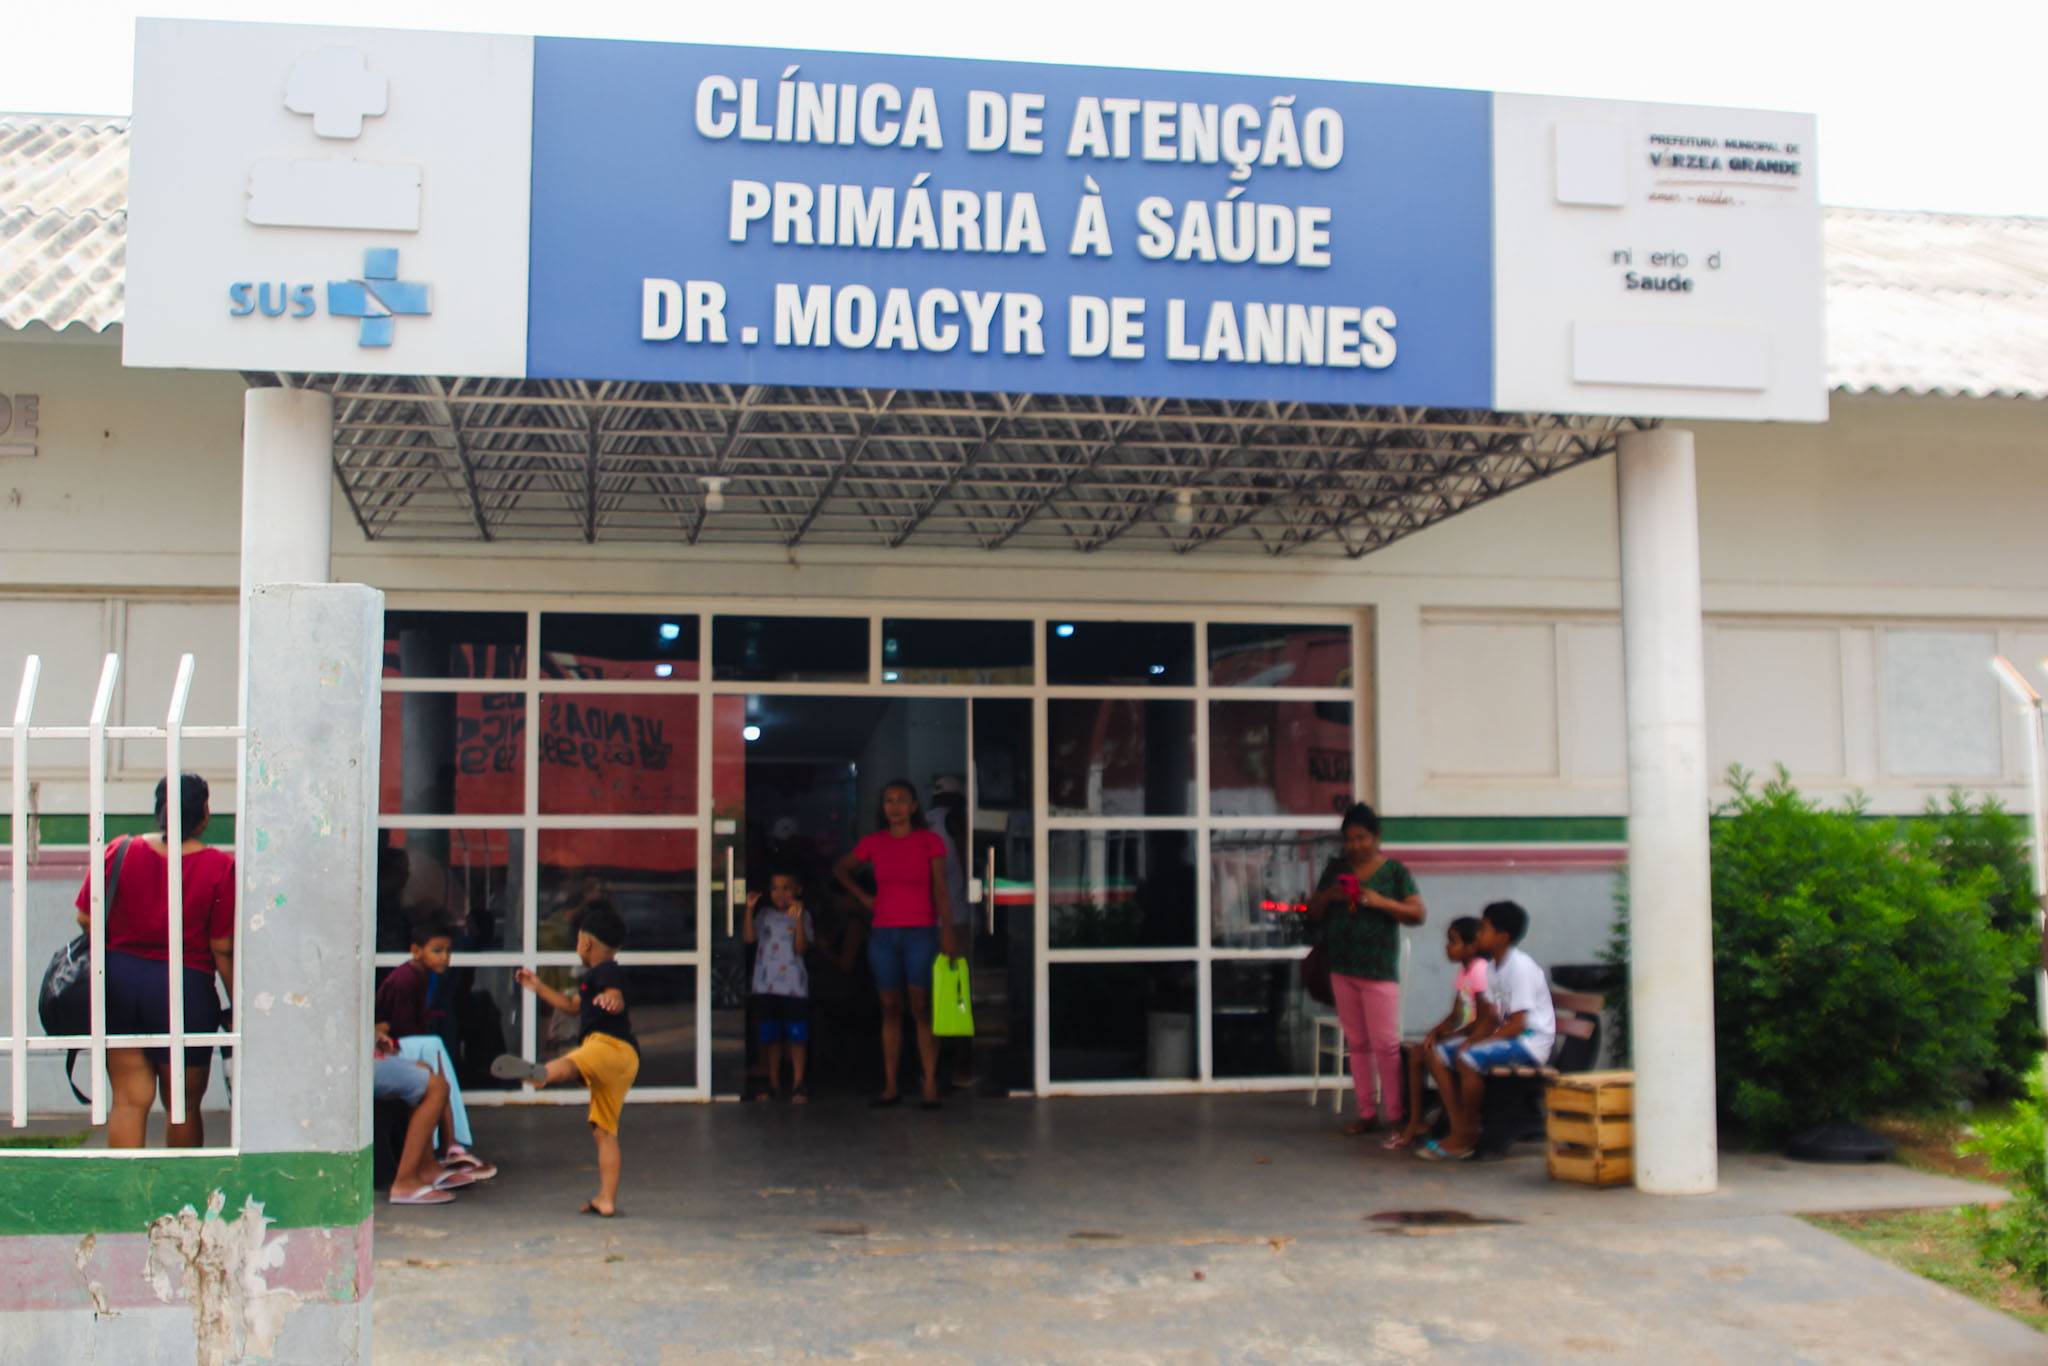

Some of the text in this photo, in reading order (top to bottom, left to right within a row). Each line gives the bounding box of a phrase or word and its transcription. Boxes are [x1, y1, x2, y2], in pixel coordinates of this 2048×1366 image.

[695, 64, 1345, 182] CLÍNICA DE ATENÇÃO
[1729, 157, 1802, 176] GRANDE
[729, 171, 1332, 268] PRIMÁRIA À SAÚDE
[229, 281, 316, 318] SUS
[641, 277, 1398, 370] DR. MOACYR DE LANNES
